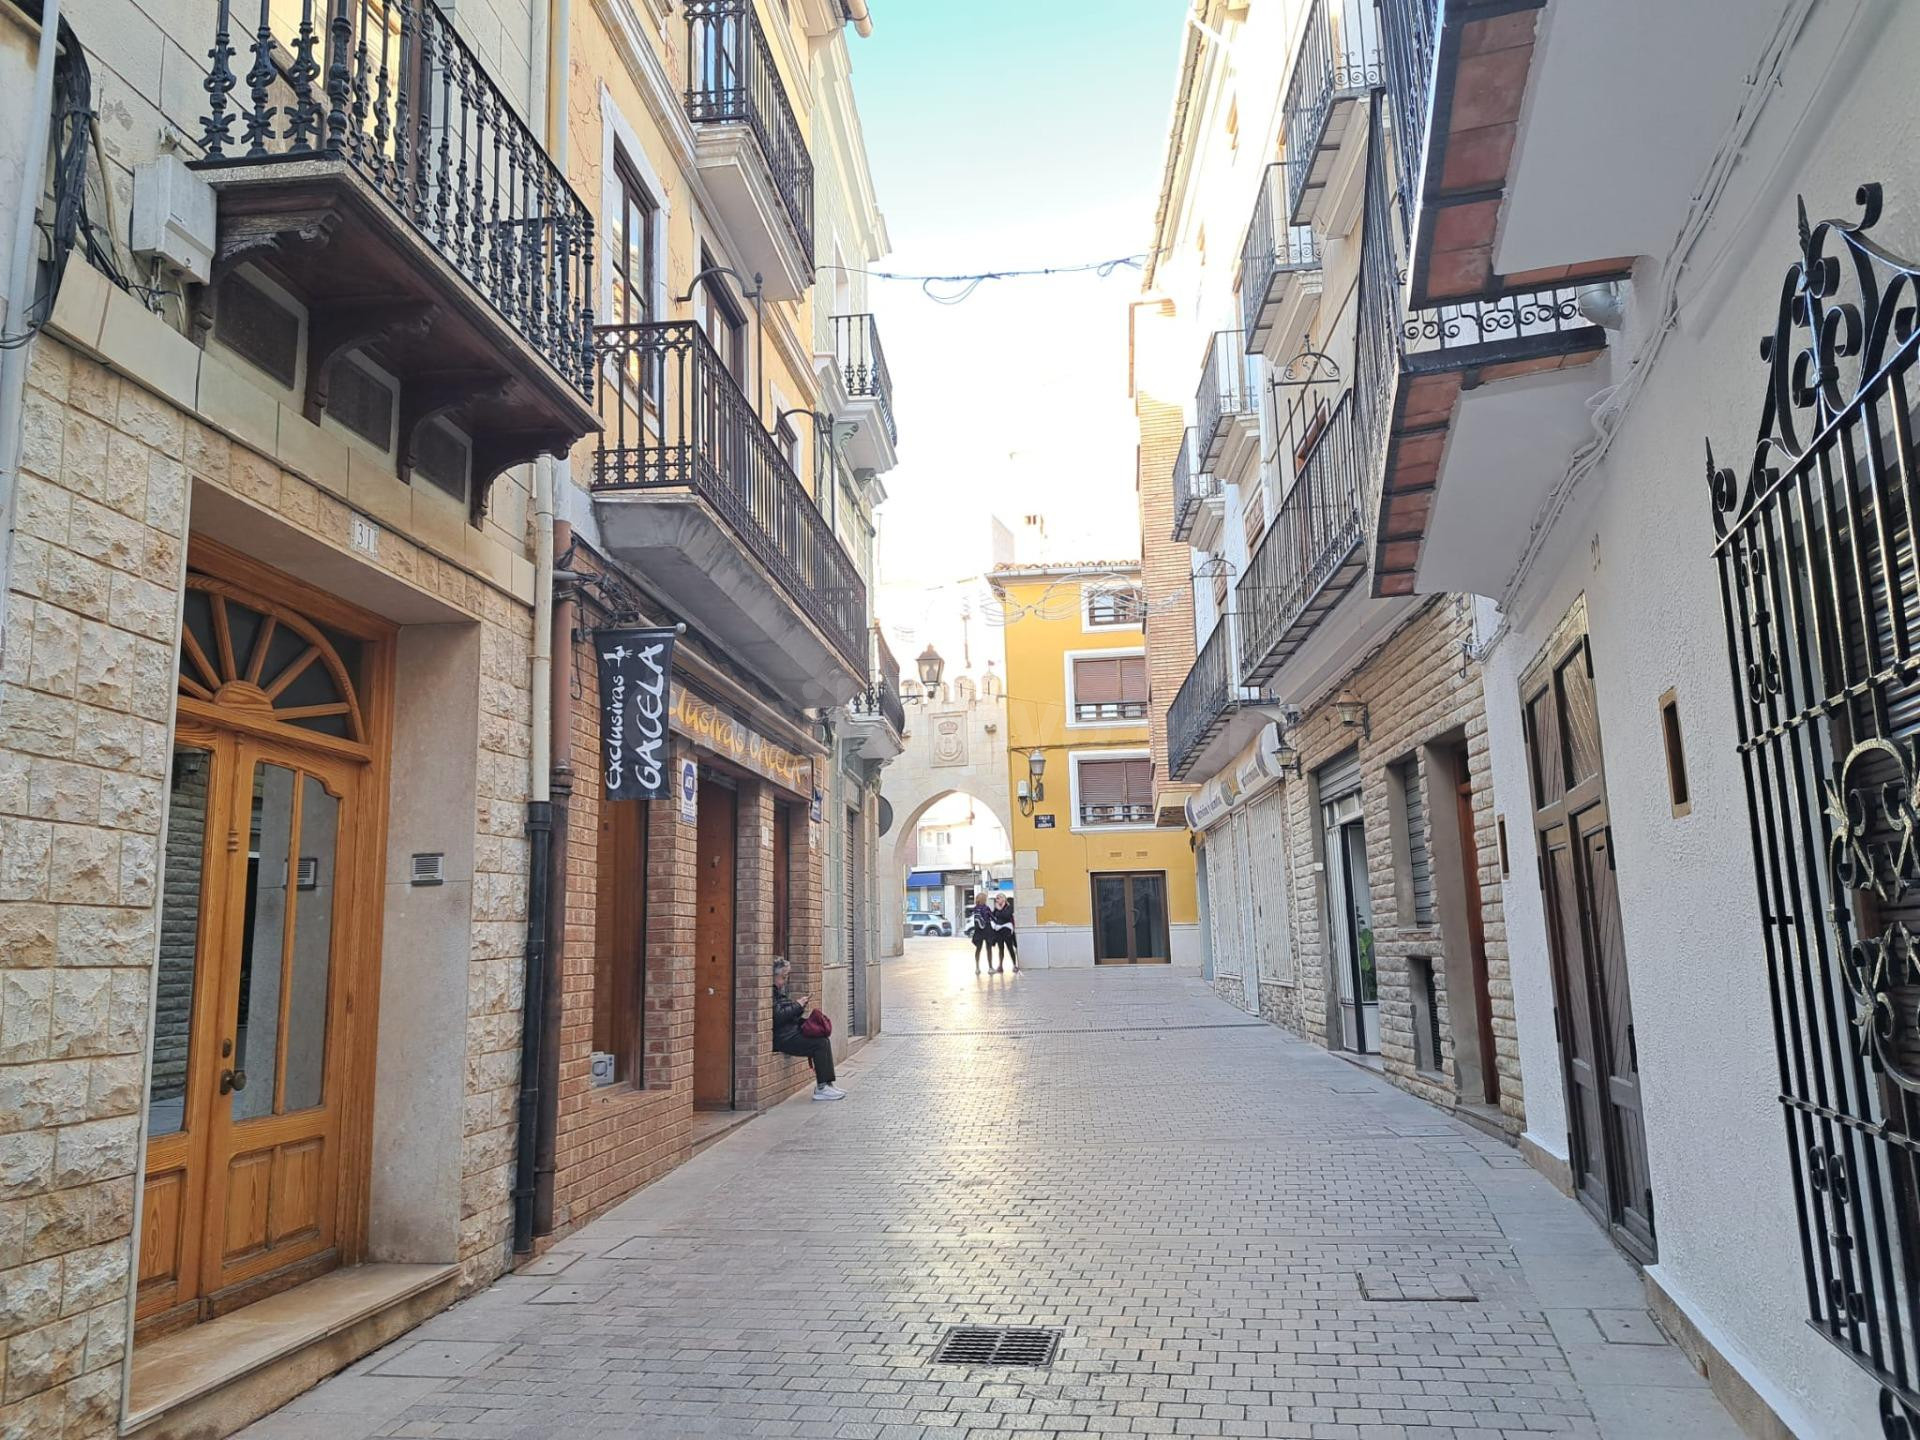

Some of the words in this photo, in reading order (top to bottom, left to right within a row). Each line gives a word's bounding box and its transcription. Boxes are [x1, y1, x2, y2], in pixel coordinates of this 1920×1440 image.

[635, 643, 665, 790] GACELA
[669, 687, 745, 753] lusivas
[749, 737, 801, 784] GACELA
